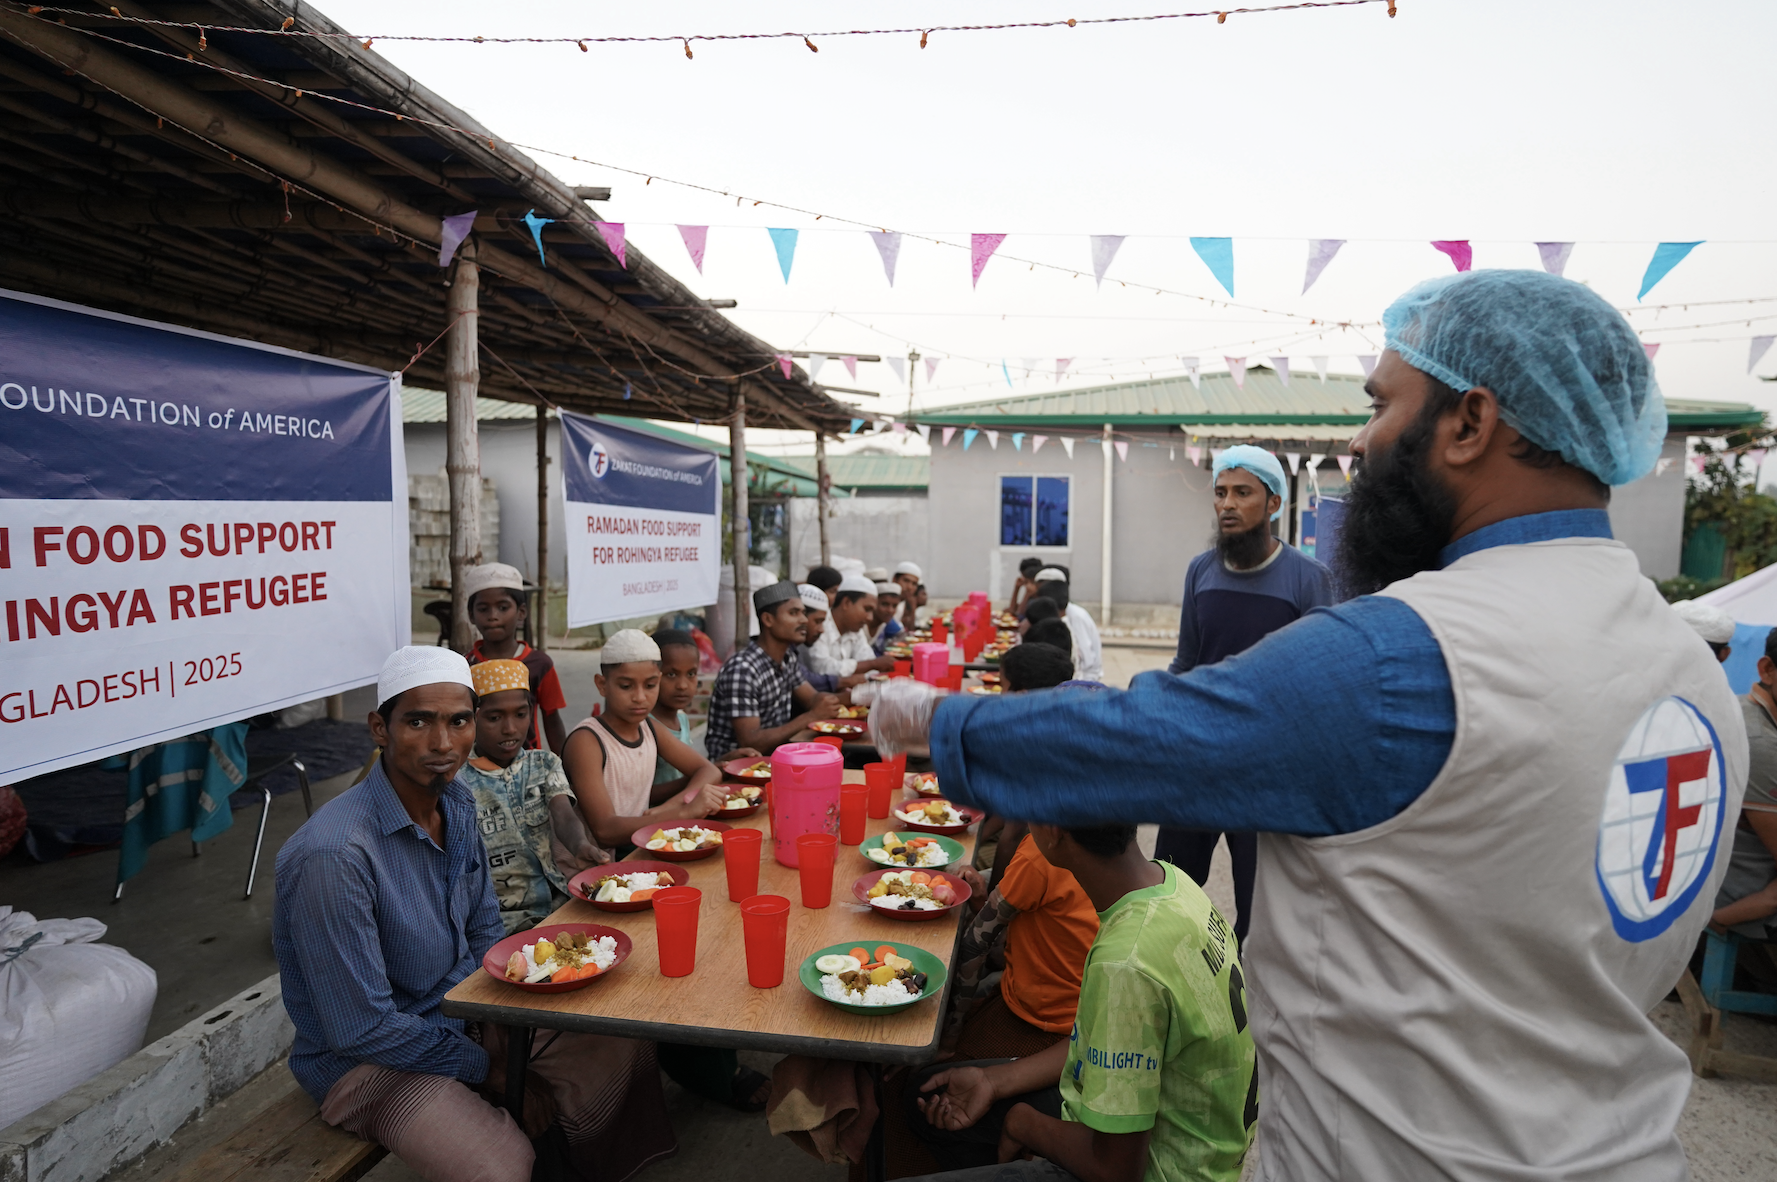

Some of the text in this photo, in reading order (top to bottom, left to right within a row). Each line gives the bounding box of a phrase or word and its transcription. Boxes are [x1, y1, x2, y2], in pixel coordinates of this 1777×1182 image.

[0, 382, 334, 440] OUNDATION of AMERICA
[611, 459, 703, 486] ZAKAT FOUNDATION of AMERICA
[587, 515, 702, 537] RAMADAN FOOD SUPPORT
[33, 524, 167, 568] FOOD
[180, 521, 337, 559] SUPPORT
[593, 546, 699, 565] FOR ROHINGYA REFUGEE
[623, 581, 662, 597] BANGLADESH
[666, 579, 679, 592] 2025
[0, 571, 328, 643] INGYA REFUGEE
[0, 666, 160, 724] GLADESH
[184, 652, 243, 686] 2025
[1146, 1056, 1159, 1071] tv
